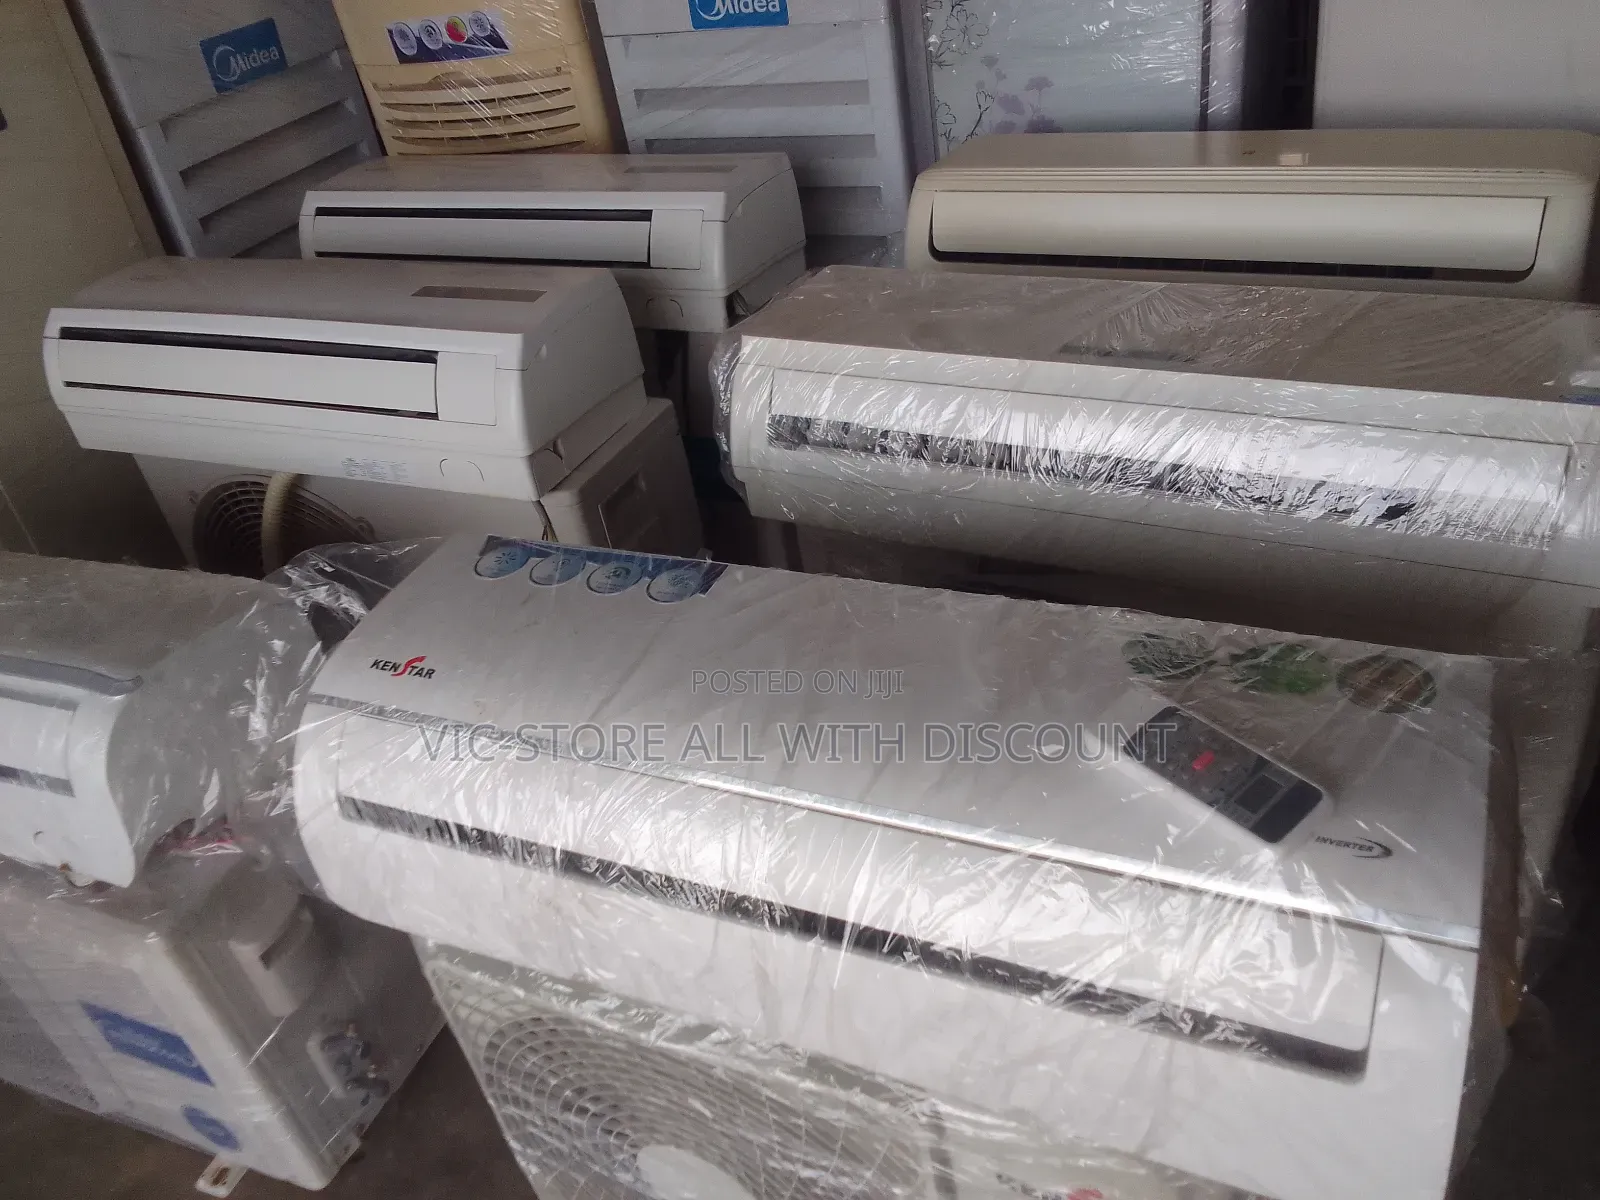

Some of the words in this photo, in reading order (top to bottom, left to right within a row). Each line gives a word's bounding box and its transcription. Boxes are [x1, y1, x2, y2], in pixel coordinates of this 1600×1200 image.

[703, 0, 781, 17] Midea
[222, 46, 280, 79] Midea
[370, 656, 436, 679] KENSTAR
[1315, 835, 1375, 853] INVERTER
